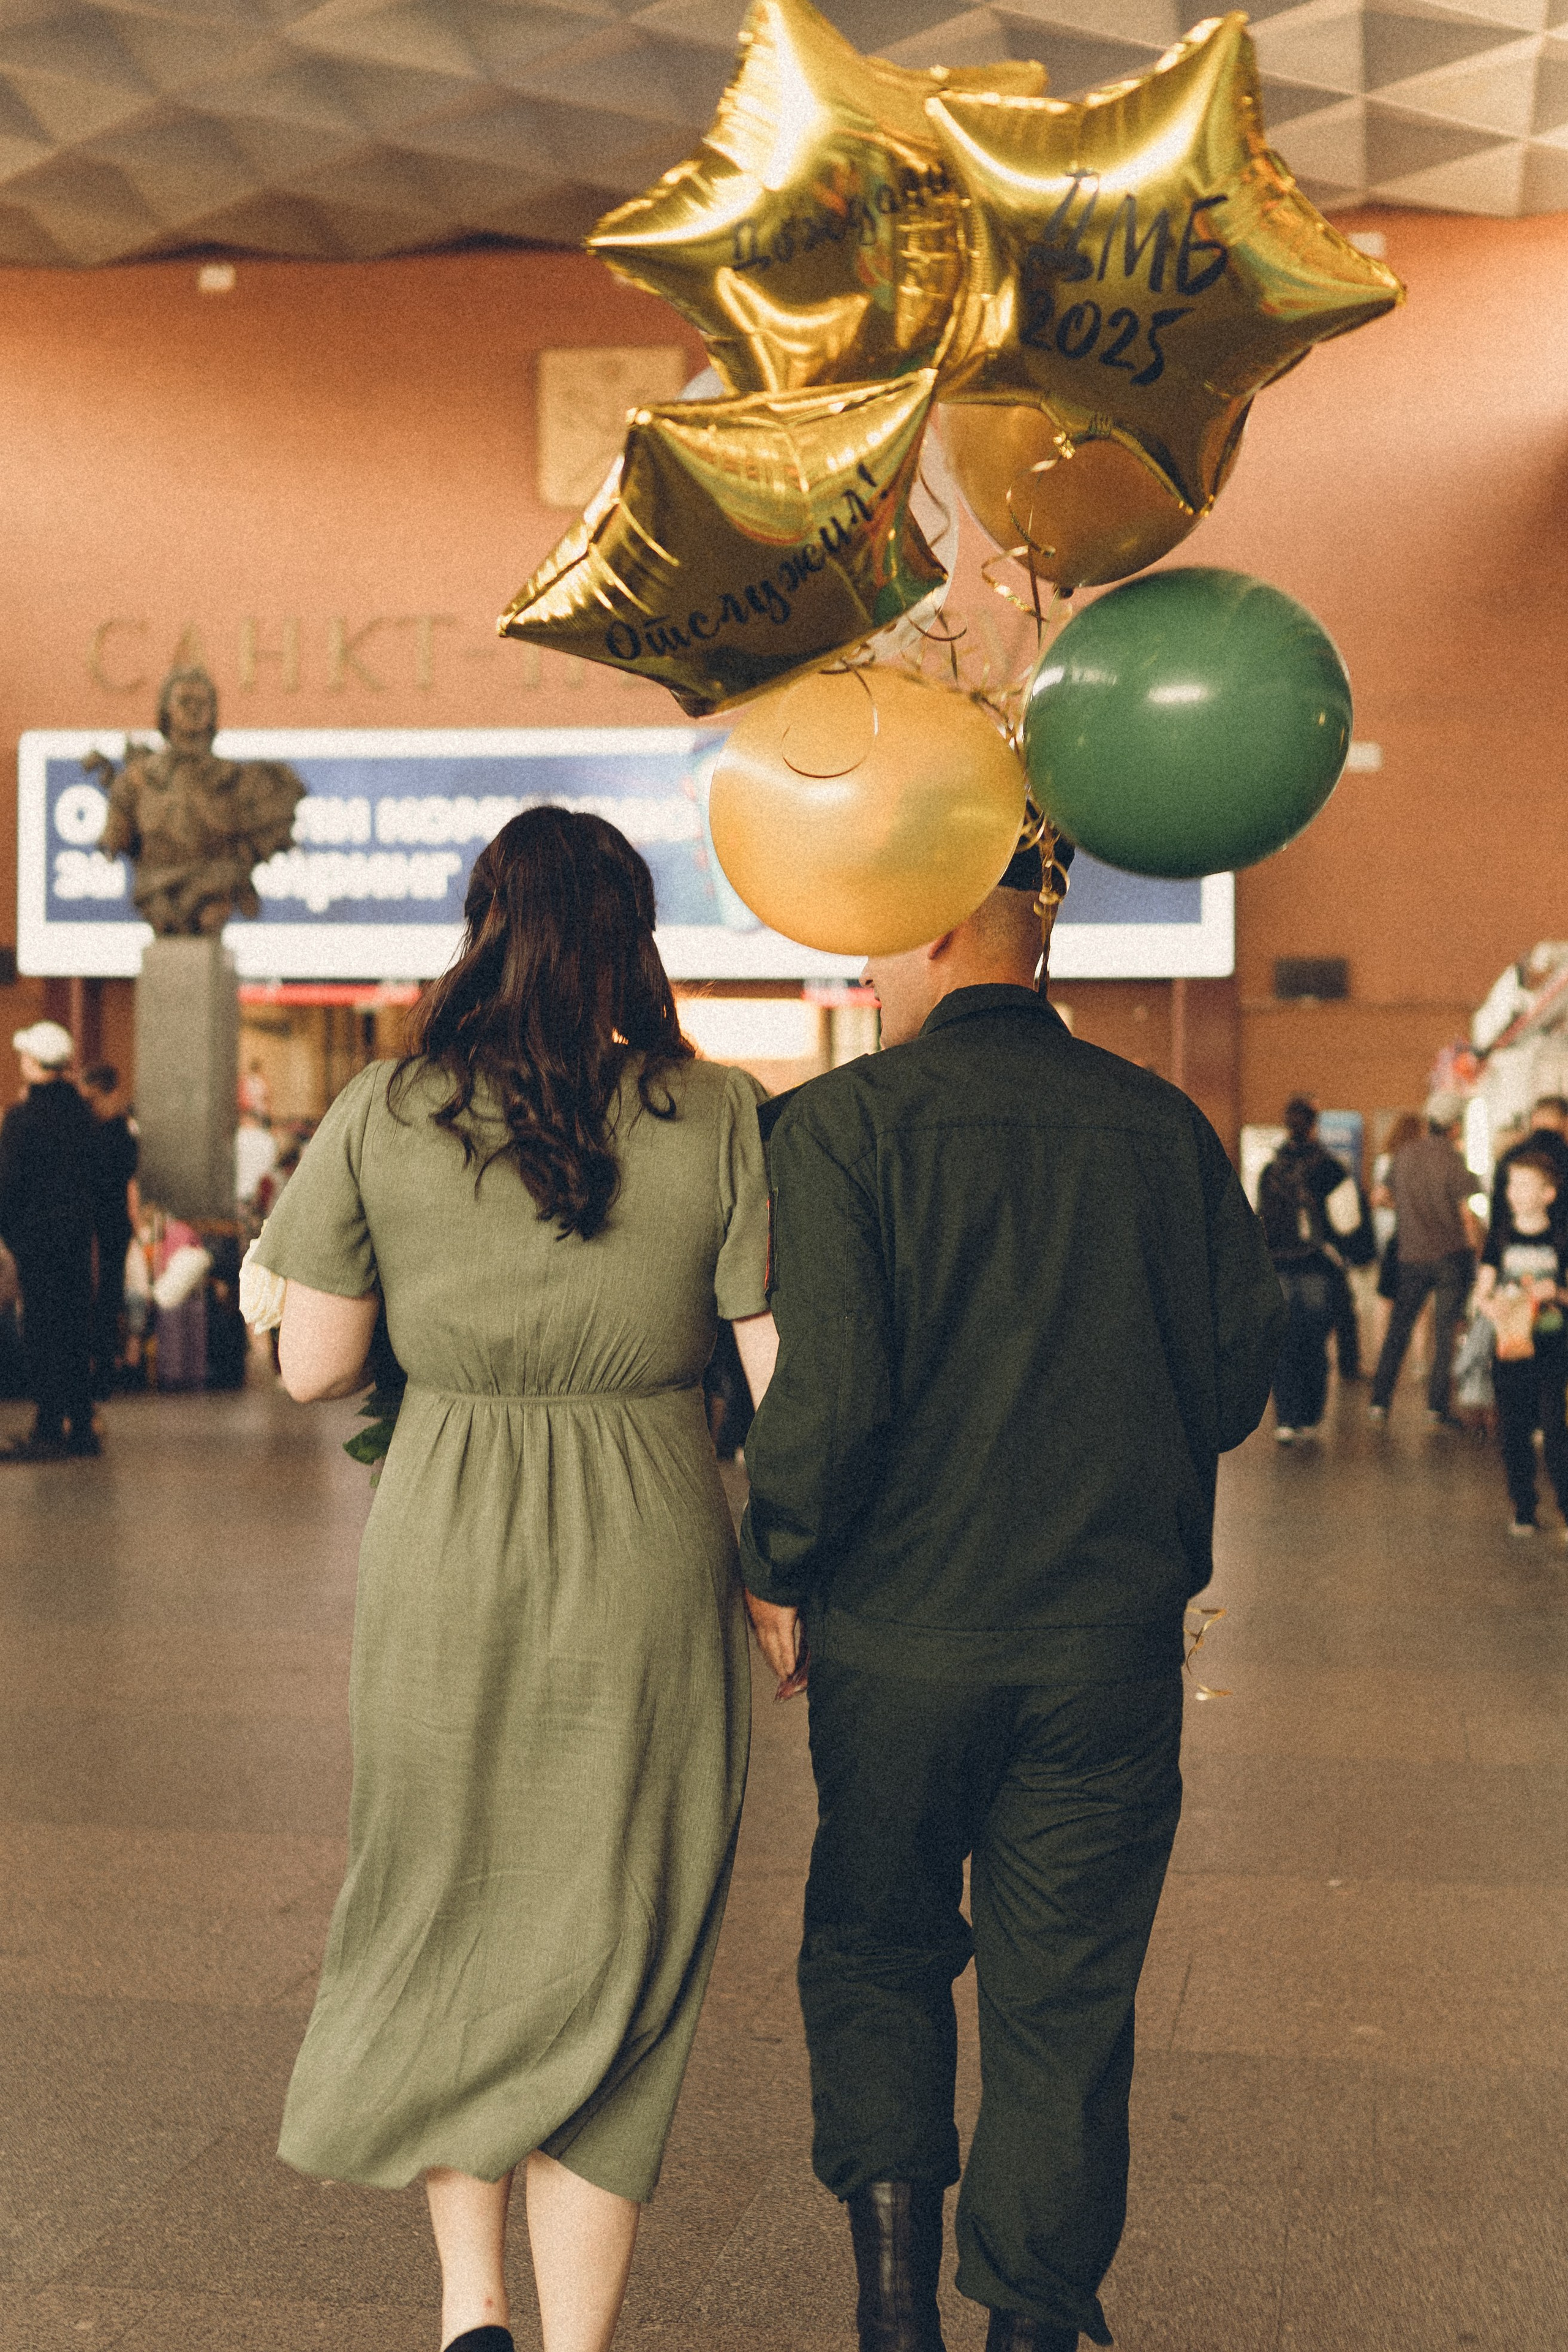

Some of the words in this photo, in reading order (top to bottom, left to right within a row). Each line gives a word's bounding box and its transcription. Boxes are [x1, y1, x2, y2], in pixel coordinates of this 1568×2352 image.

[1023, 169, 1229, 296] ДМБ
[1019, 288, 1194, 386] 2025
[605, 462, 889, 660] Отслужил!
